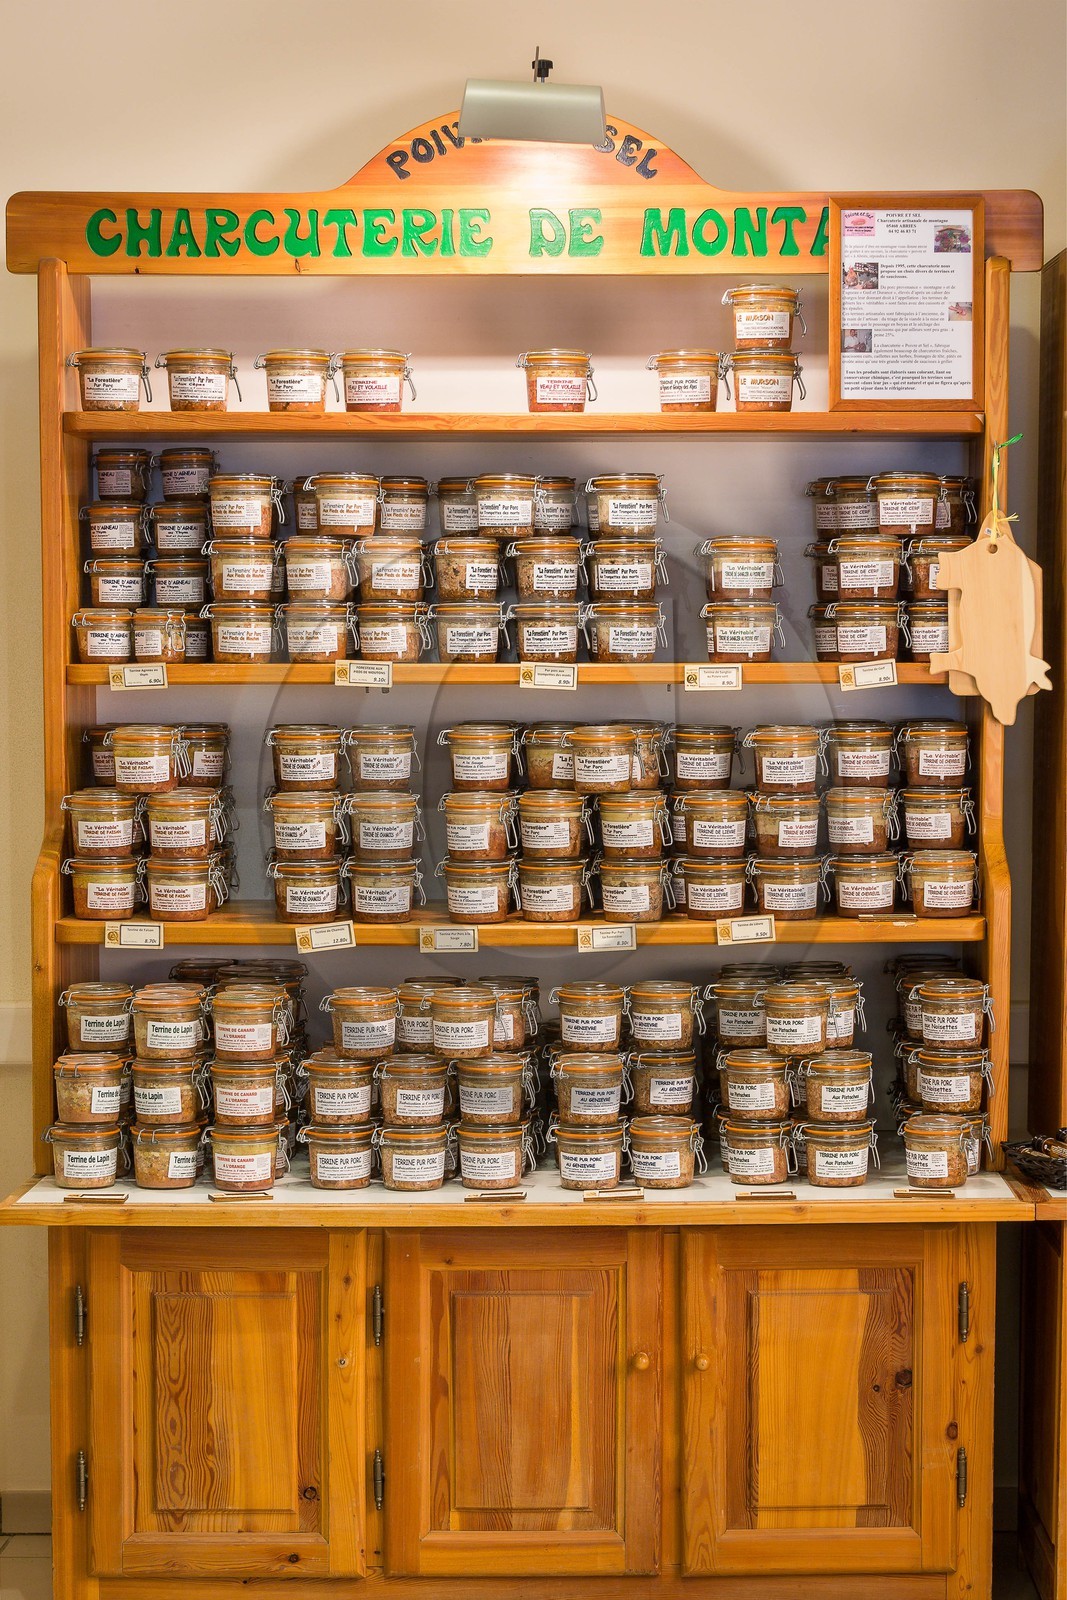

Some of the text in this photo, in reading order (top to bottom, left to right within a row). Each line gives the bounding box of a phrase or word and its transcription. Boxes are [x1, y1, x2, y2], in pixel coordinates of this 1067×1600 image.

[386, 122, 658, 180] POIV SEL
[86, 208, 493, 257] CHARCUTERIE
[529, 208, 603, 257] DE
